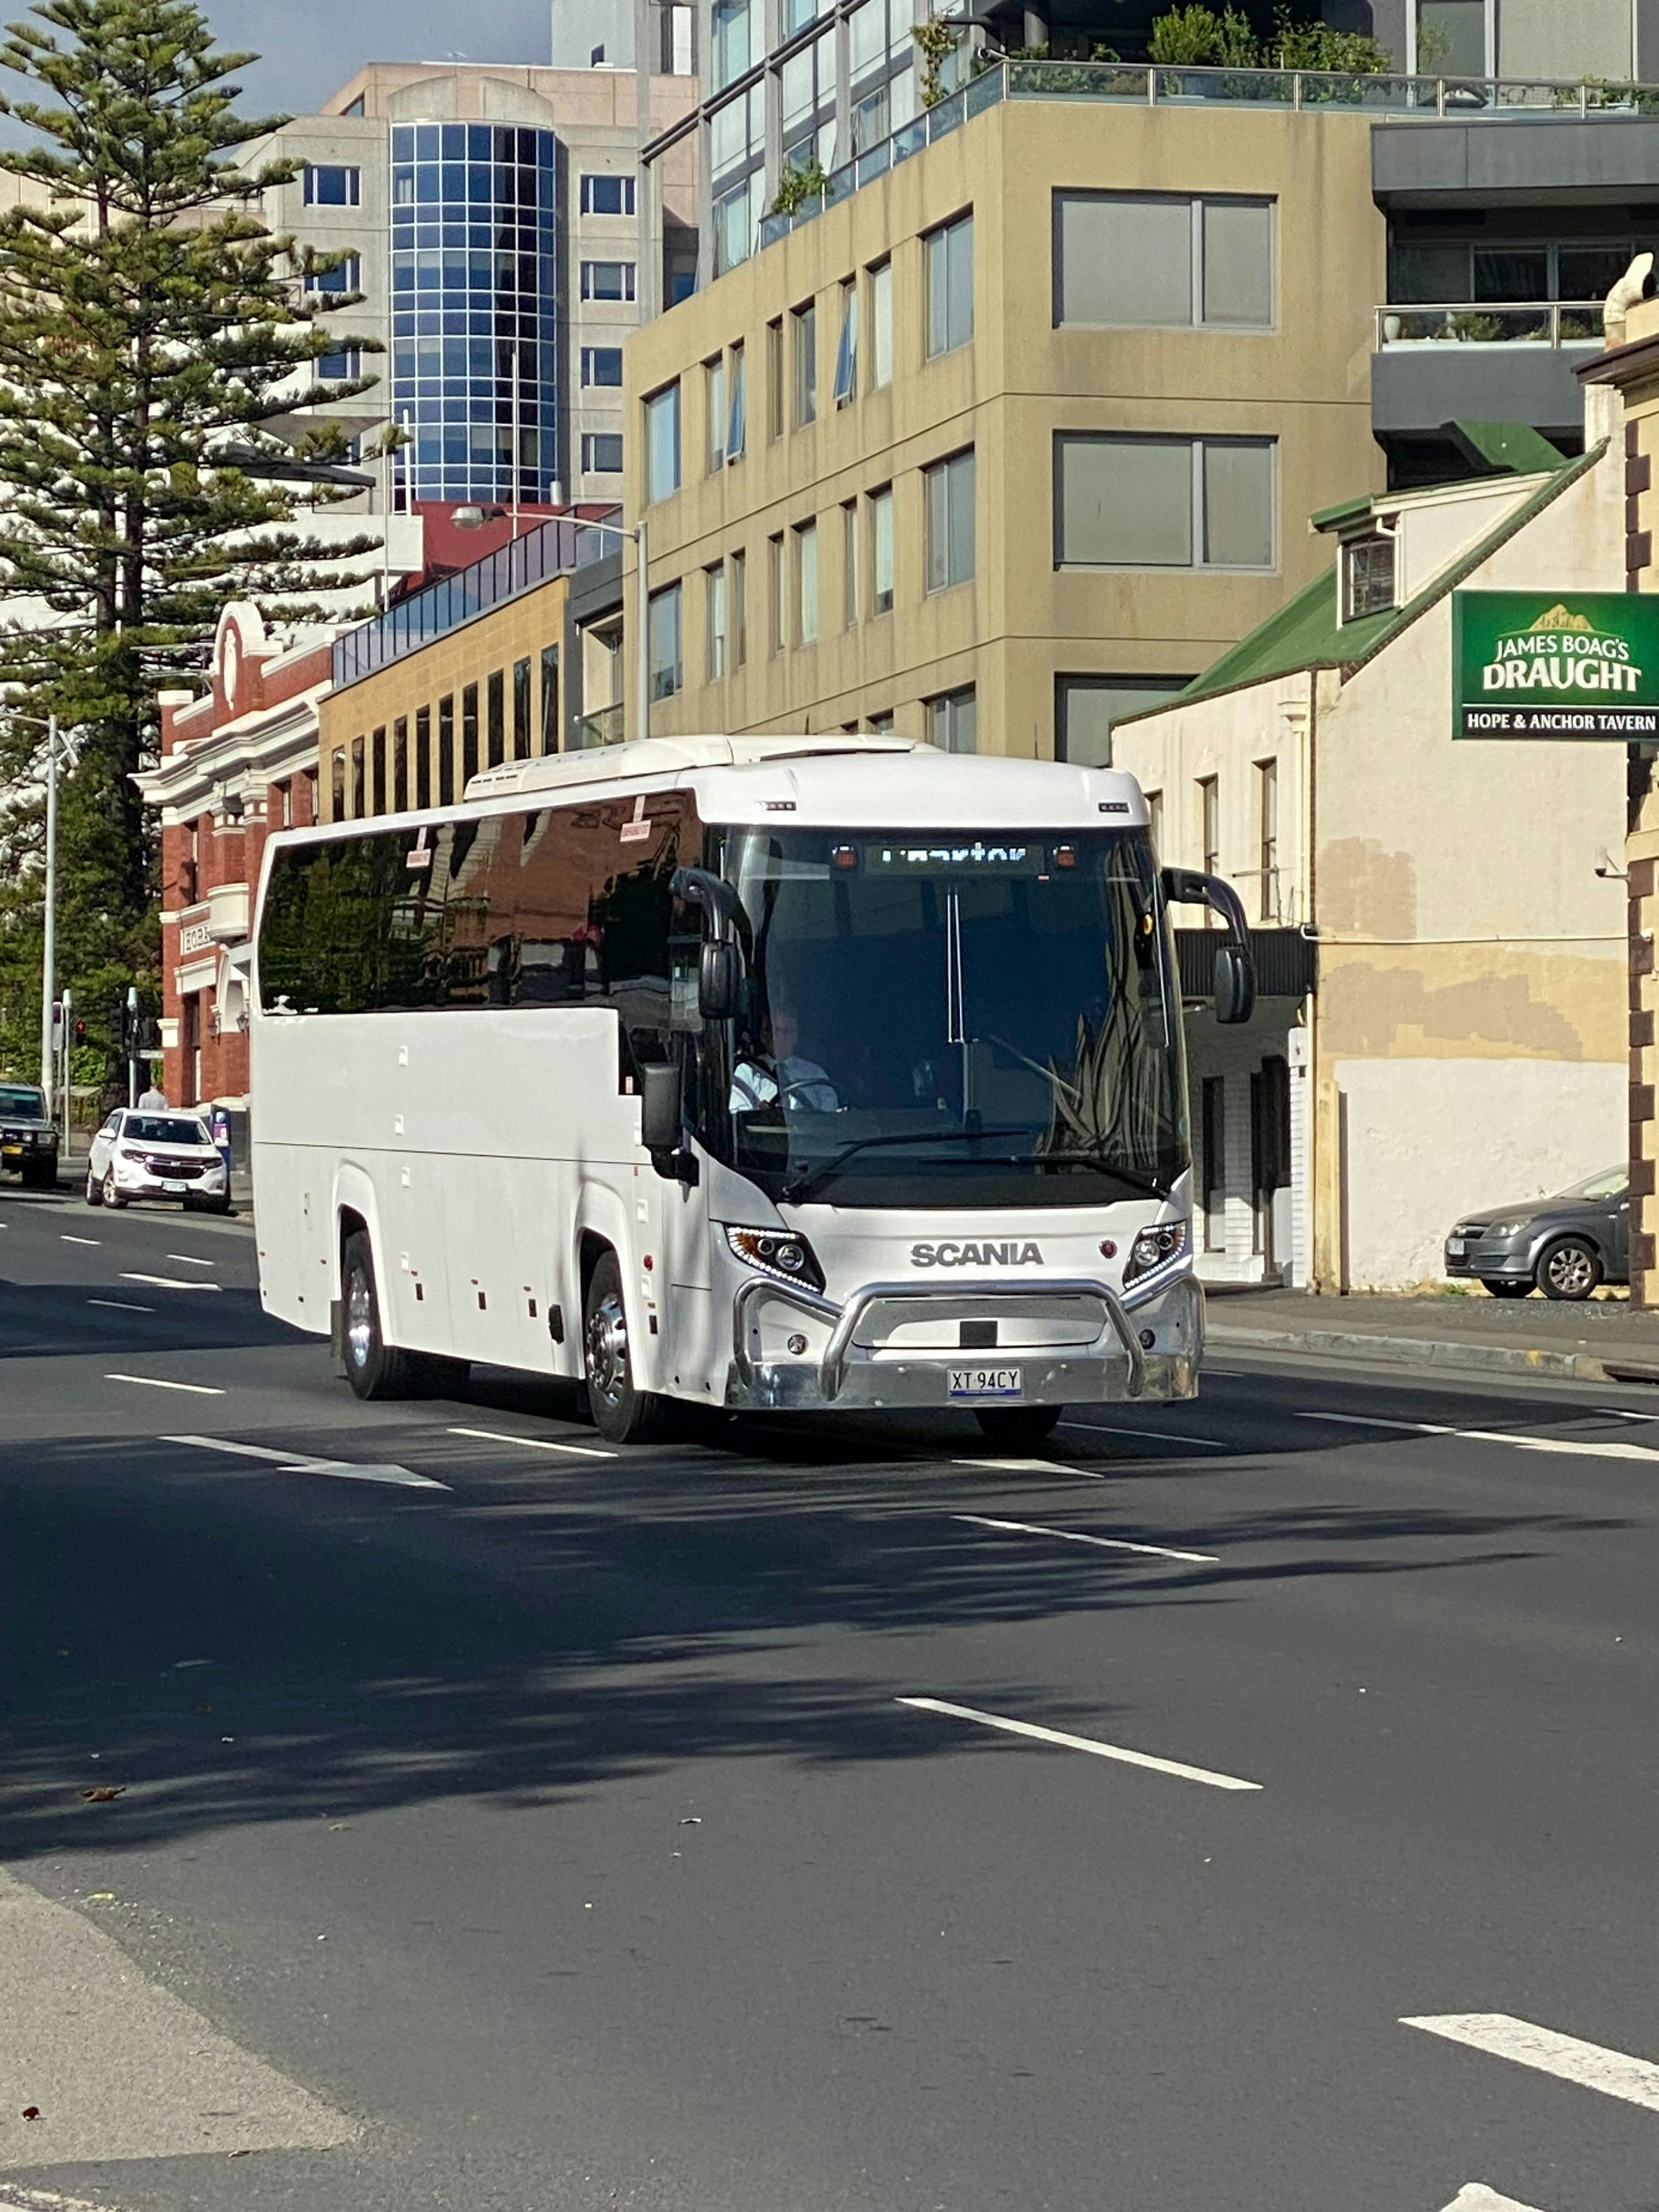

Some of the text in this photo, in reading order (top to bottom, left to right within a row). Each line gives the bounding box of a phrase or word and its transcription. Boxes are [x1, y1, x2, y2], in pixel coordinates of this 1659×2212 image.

[1494, 635, 1629, 662] JAMES BOAG'S
[1483, 657, 1642, 692] DRAUGHT
[1468, 713, 1656, 731] HOPE & ANCHOR TAVERN
[910, 1242, 1044, 1267] SCANIA
[952, 1371, 1018, 1389] XT 94CY
